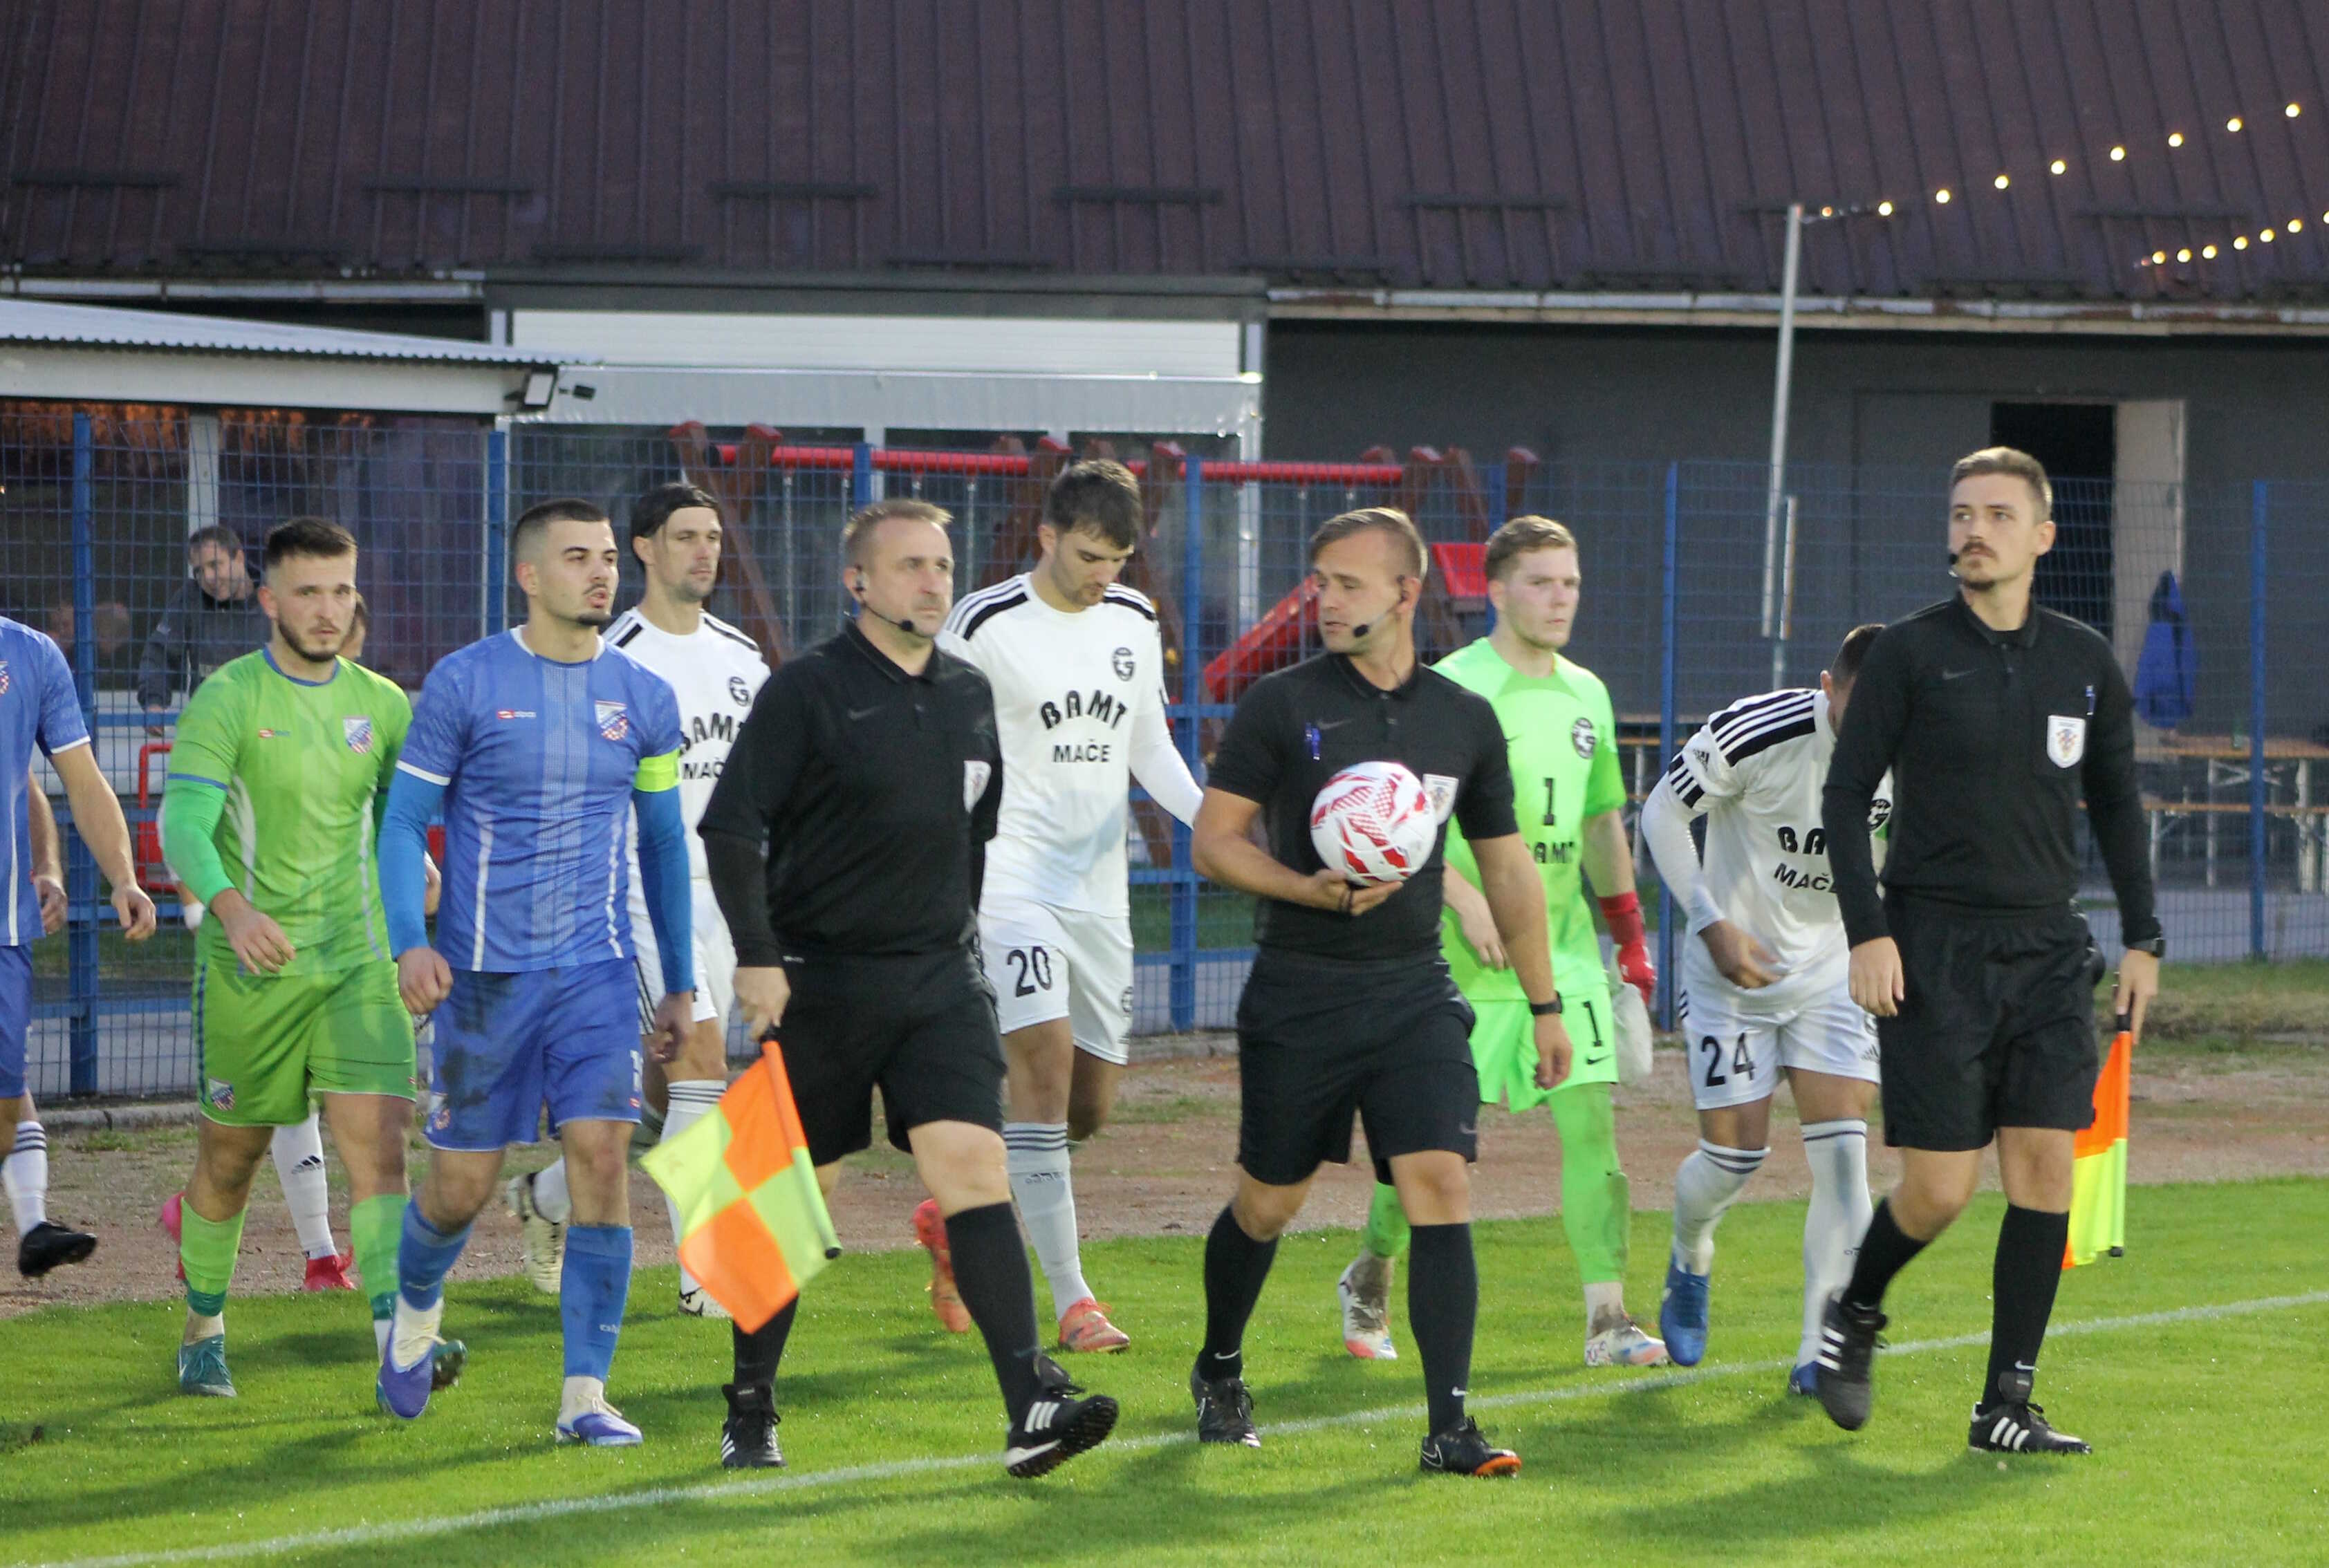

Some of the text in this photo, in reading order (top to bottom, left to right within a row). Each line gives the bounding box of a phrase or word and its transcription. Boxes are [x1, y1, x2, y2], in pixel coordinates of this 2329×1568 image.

[1041, 689, 1127, 729] BAMT
[683, 756, 725, 779] MAČ
[1053, 738, 1111, 762] MAČE
[1543, 777, 1555, 825] 1
[1777, 826, 1827, 855] BA
[1774, 863, 1837, 893] MAČ
[1008, 946, 1052, 997] 20
[1583, 1000, 1602, 1047] 1
[1701, 1032, 1756, 1087] 24
